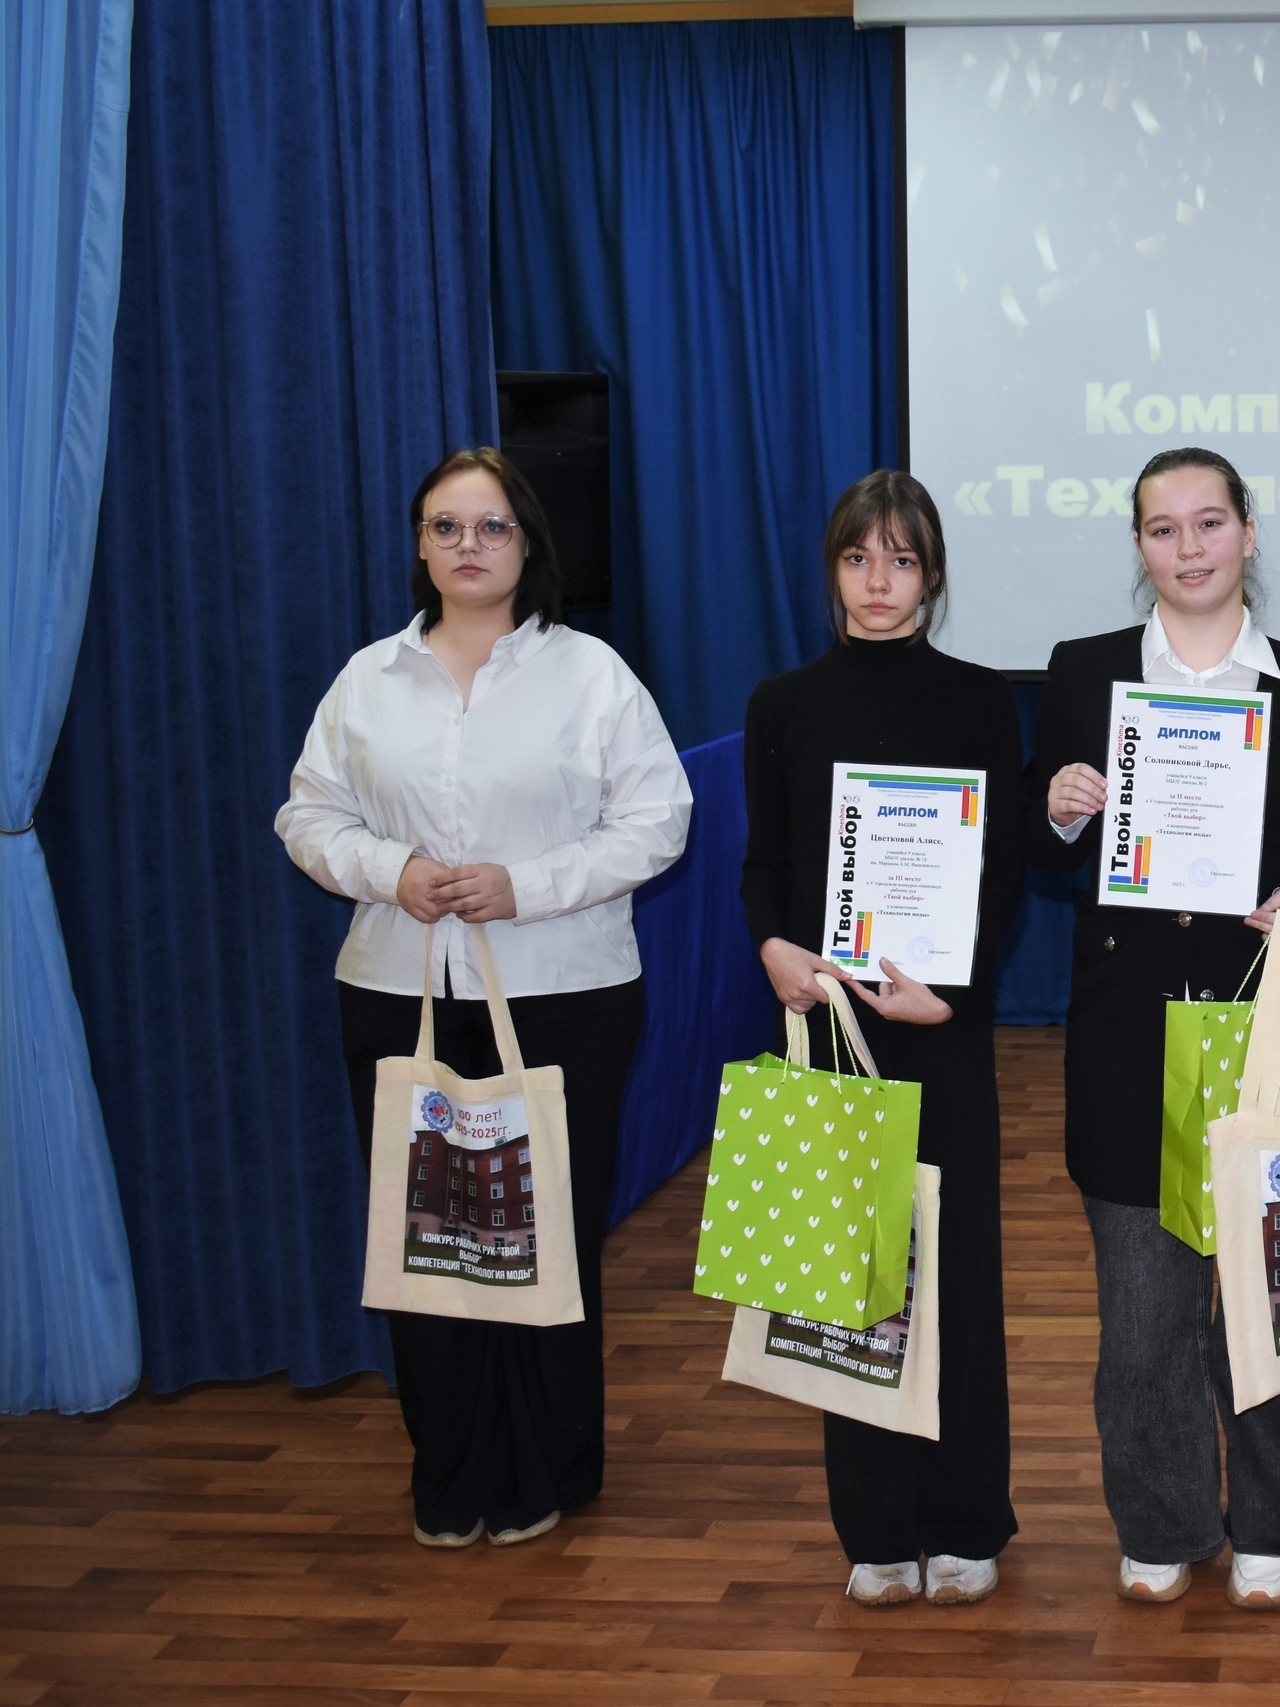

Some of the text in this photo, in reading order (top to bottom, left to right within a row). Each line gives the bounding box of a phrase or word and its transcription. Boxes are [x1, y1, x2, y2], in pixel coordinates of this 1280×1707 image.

[1116, 725, 1124, 757] Kineshma
[1157, 727, 1221, 741] ДИПЛОМ
[1144, 755, 1231, 770] Солониковой Дарье,
[1111, 726, 1141, 872] Твой выбор
[838, 804, 846, 836] Kineshma
[877, 806, 938, 819] ДИПЛОМ
[871, 834, 914, 843] Цветковой
[833, 806, 862, 947] Твой выбор
[475, 1108, 502, 1123] лет!
[422, 1232, 455, 1246] КОНКУРС
[455, 1236, 482, 1253] РАБОЧИХ
[408, 1255, 460, 1271] КОМПЕТЕНЦИЯ
[506, 1268, 534, 1281] МОДЫ"
[819, 1323, 850, 1342] РАБОЧИХ
[770, 1337, 823, 1359] КОМПЕТЕНЦИЯ
[869, 1364, 898, 1380] МОДЫ"
